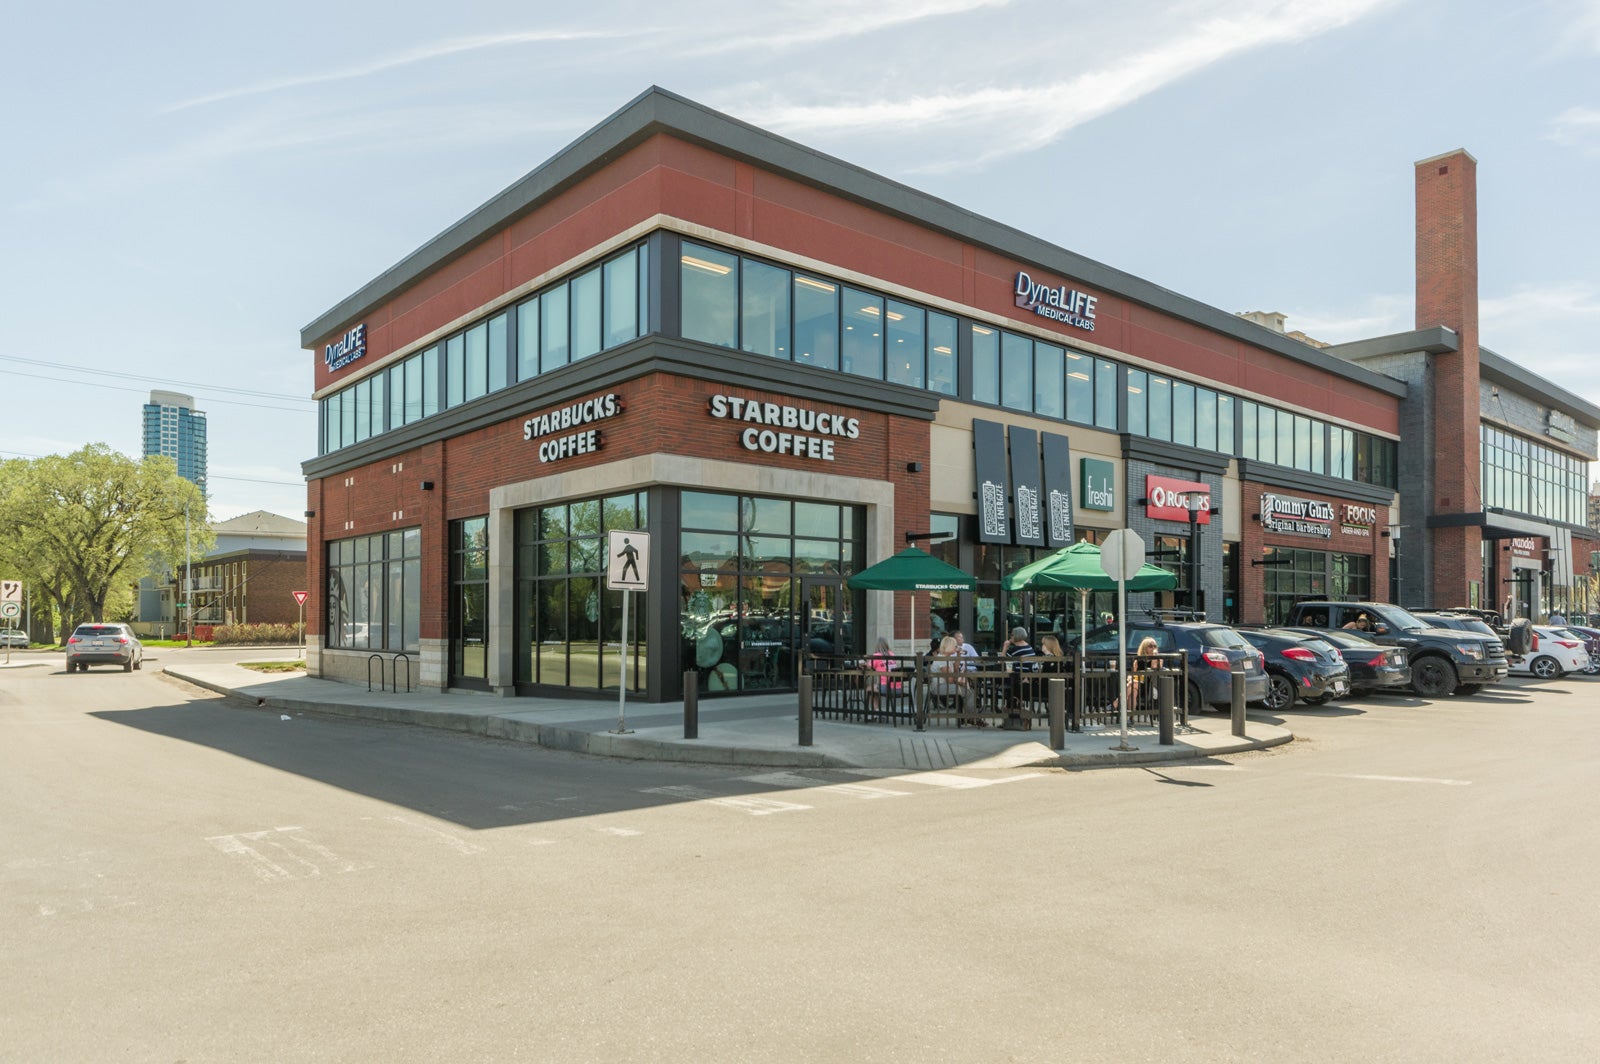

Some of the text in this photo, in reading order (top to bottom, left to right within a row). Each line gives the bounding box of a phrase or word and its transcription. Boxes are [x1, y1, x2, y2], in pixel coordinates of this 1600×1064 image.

[1016, 271, 1098, 319] DynaLIFE
[1037, 305, 1095, 331] MEDICAL LABS
[325, 323, 363, 367] DynaLIFE
[523, 393, 615, 440] STARBUCKS
[711, 394, 860, 439] STARBUCKS
[539, 429, 597, 463] COFFEE
[742, 428, 835, 461] COFFEE
[1088, 475, 1113, 507] freshii
[1165, 490, 1210, 511] ROGRS
[1266, 495, 1335, 520] Tommy Gun's
[1347, 505, 1376, 524] FOCUS
